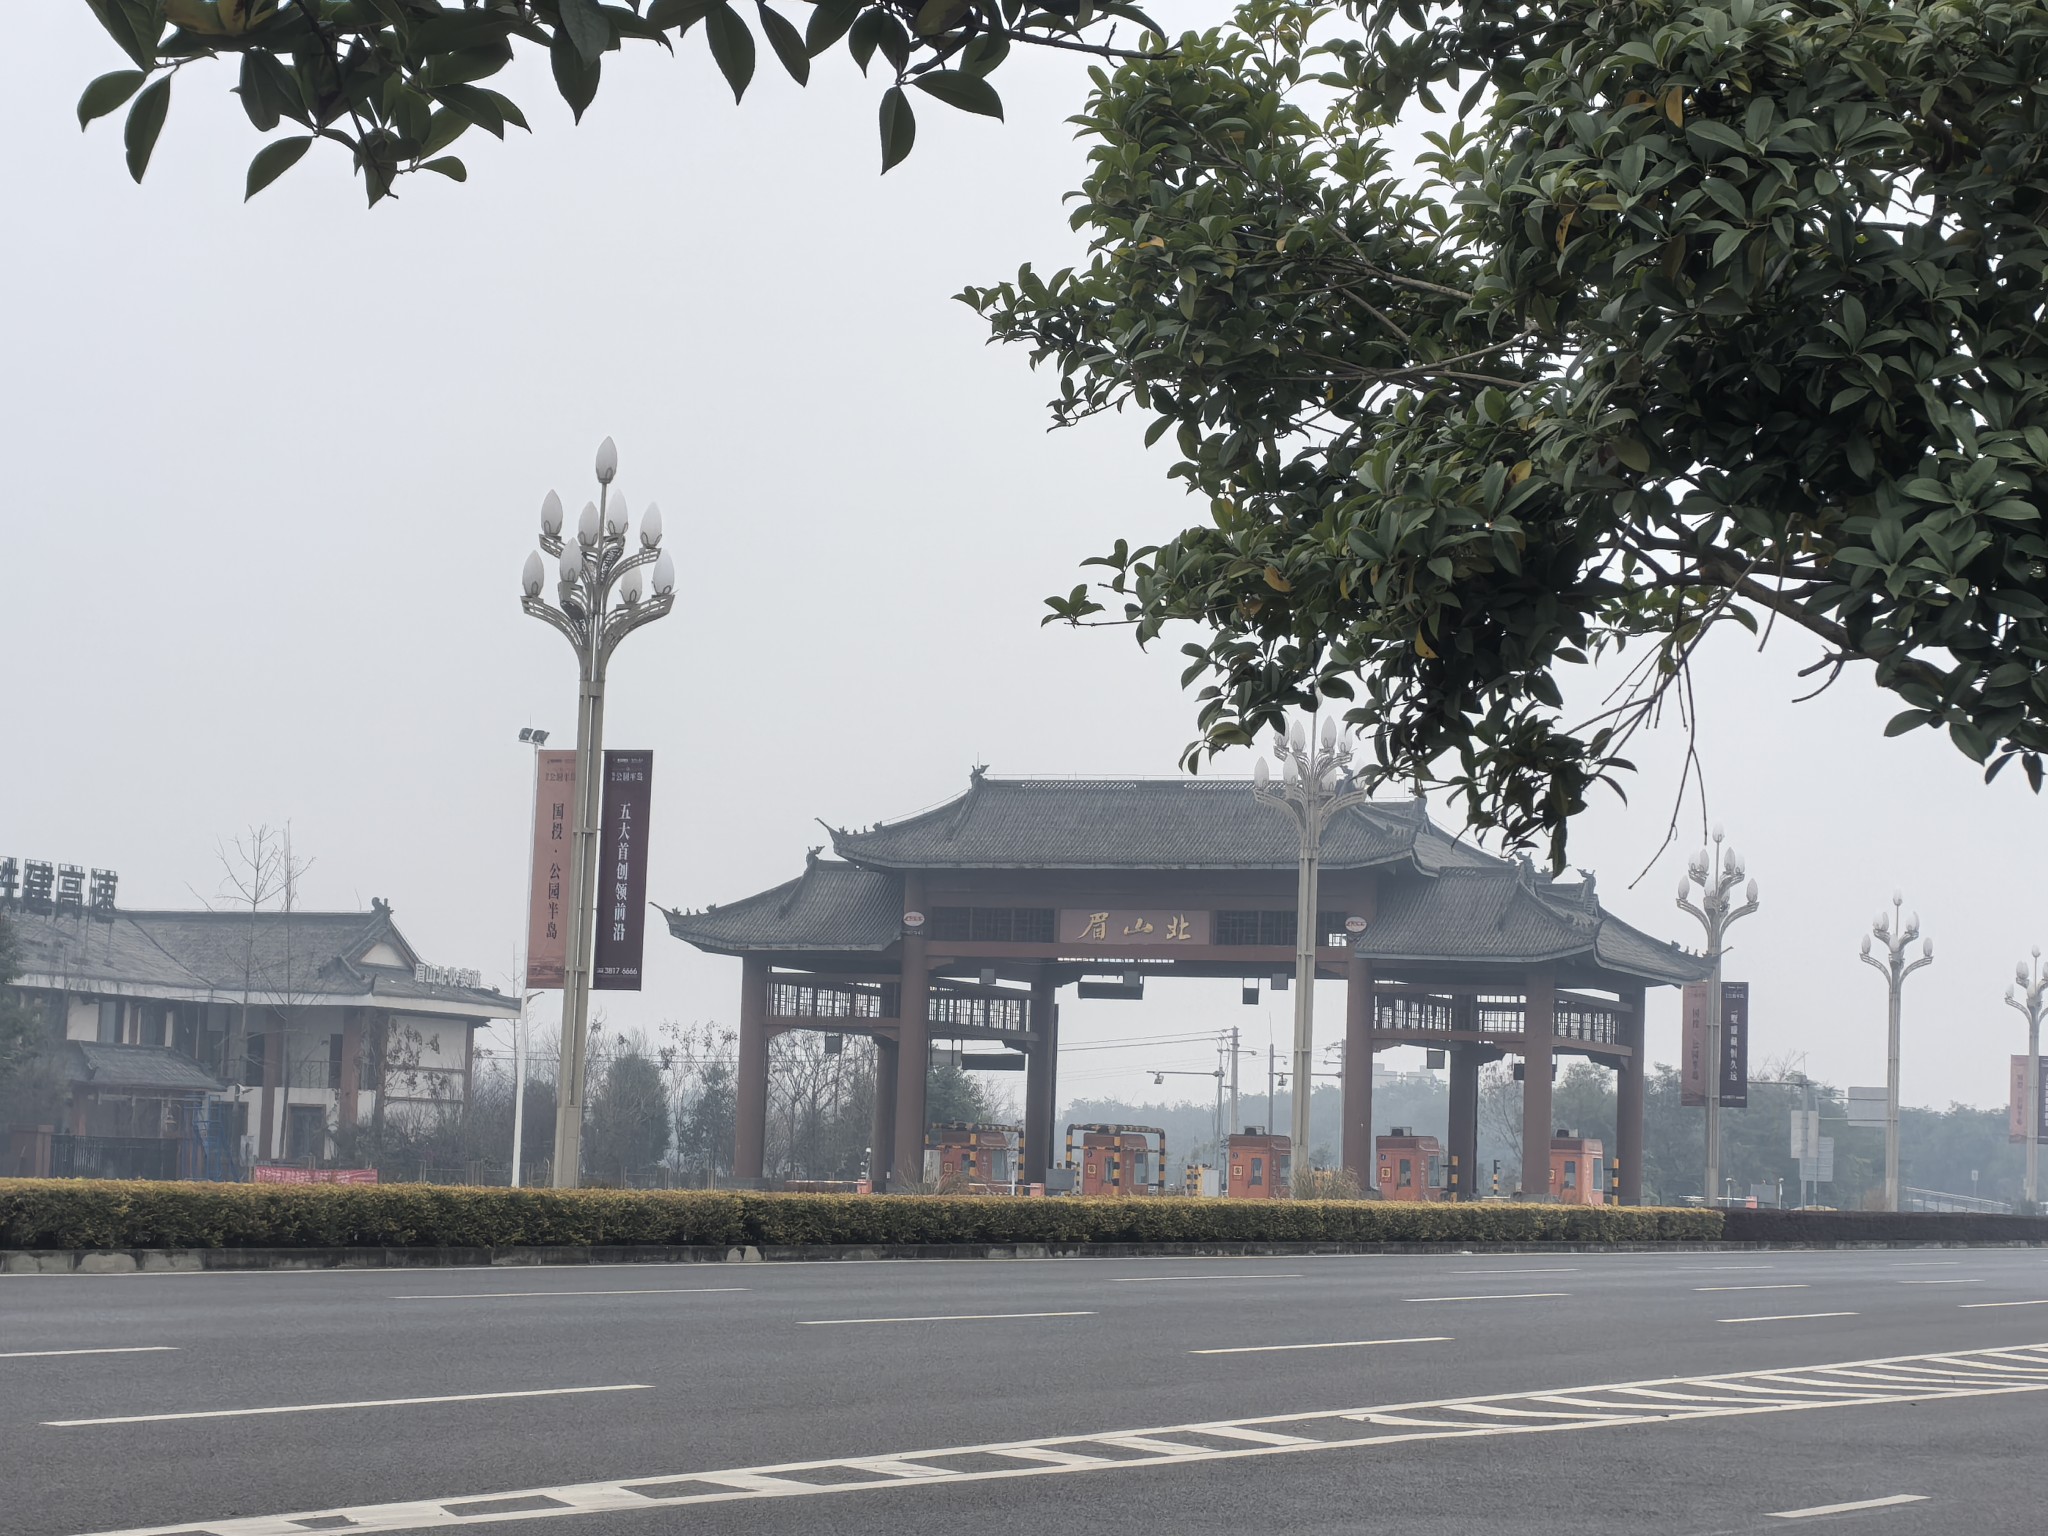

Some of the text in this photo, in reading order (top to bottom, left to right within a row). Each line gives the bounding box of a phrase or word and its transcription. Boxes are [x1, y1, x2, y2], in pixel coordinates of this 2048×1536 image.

[546, 802, 564, 940] 国投·公园半岛
[613, 802, 632, 942] 五大首创领前沿
[1076, 911, 1192, 941] 眉山北
[604, 967, 620, 975] 3817
